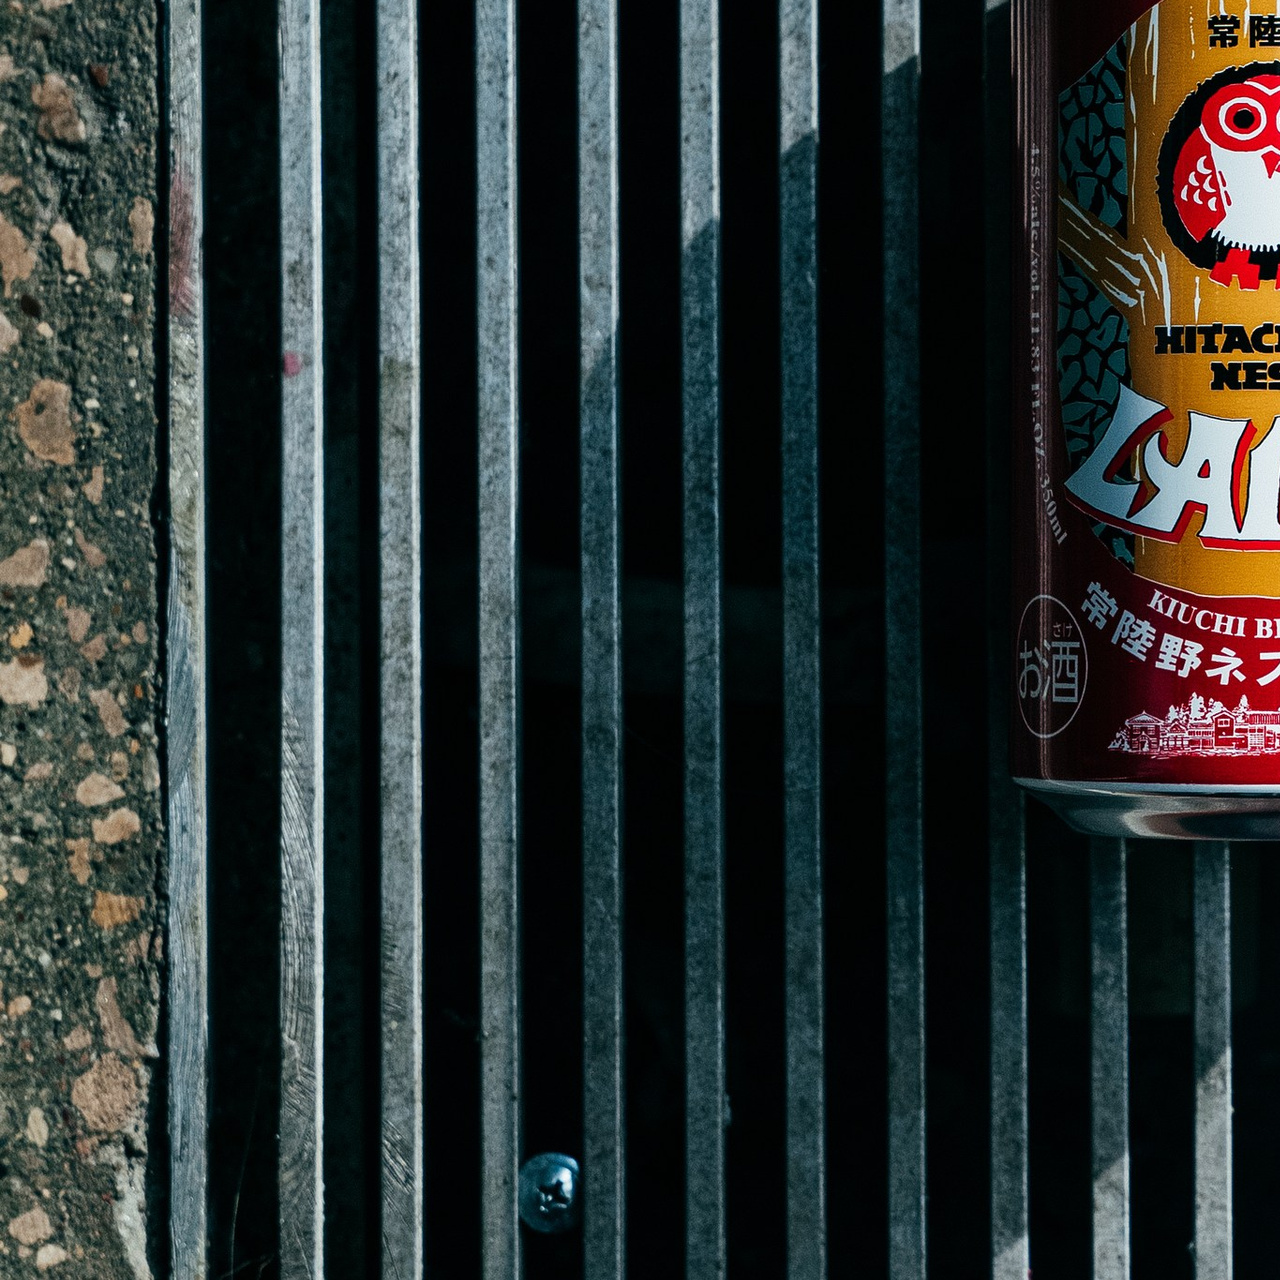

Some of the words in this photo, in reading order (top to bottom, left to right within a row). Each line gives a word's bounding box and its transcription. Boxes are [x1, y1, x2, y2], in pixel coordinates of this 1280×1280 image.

[1040, 472, 1068, 545] 350ml
[1052, 622, 1073, 638] さけ
[1147, 588, 1248, 638] KIUCHI
[1019, 639, 1080, 703] お酒
